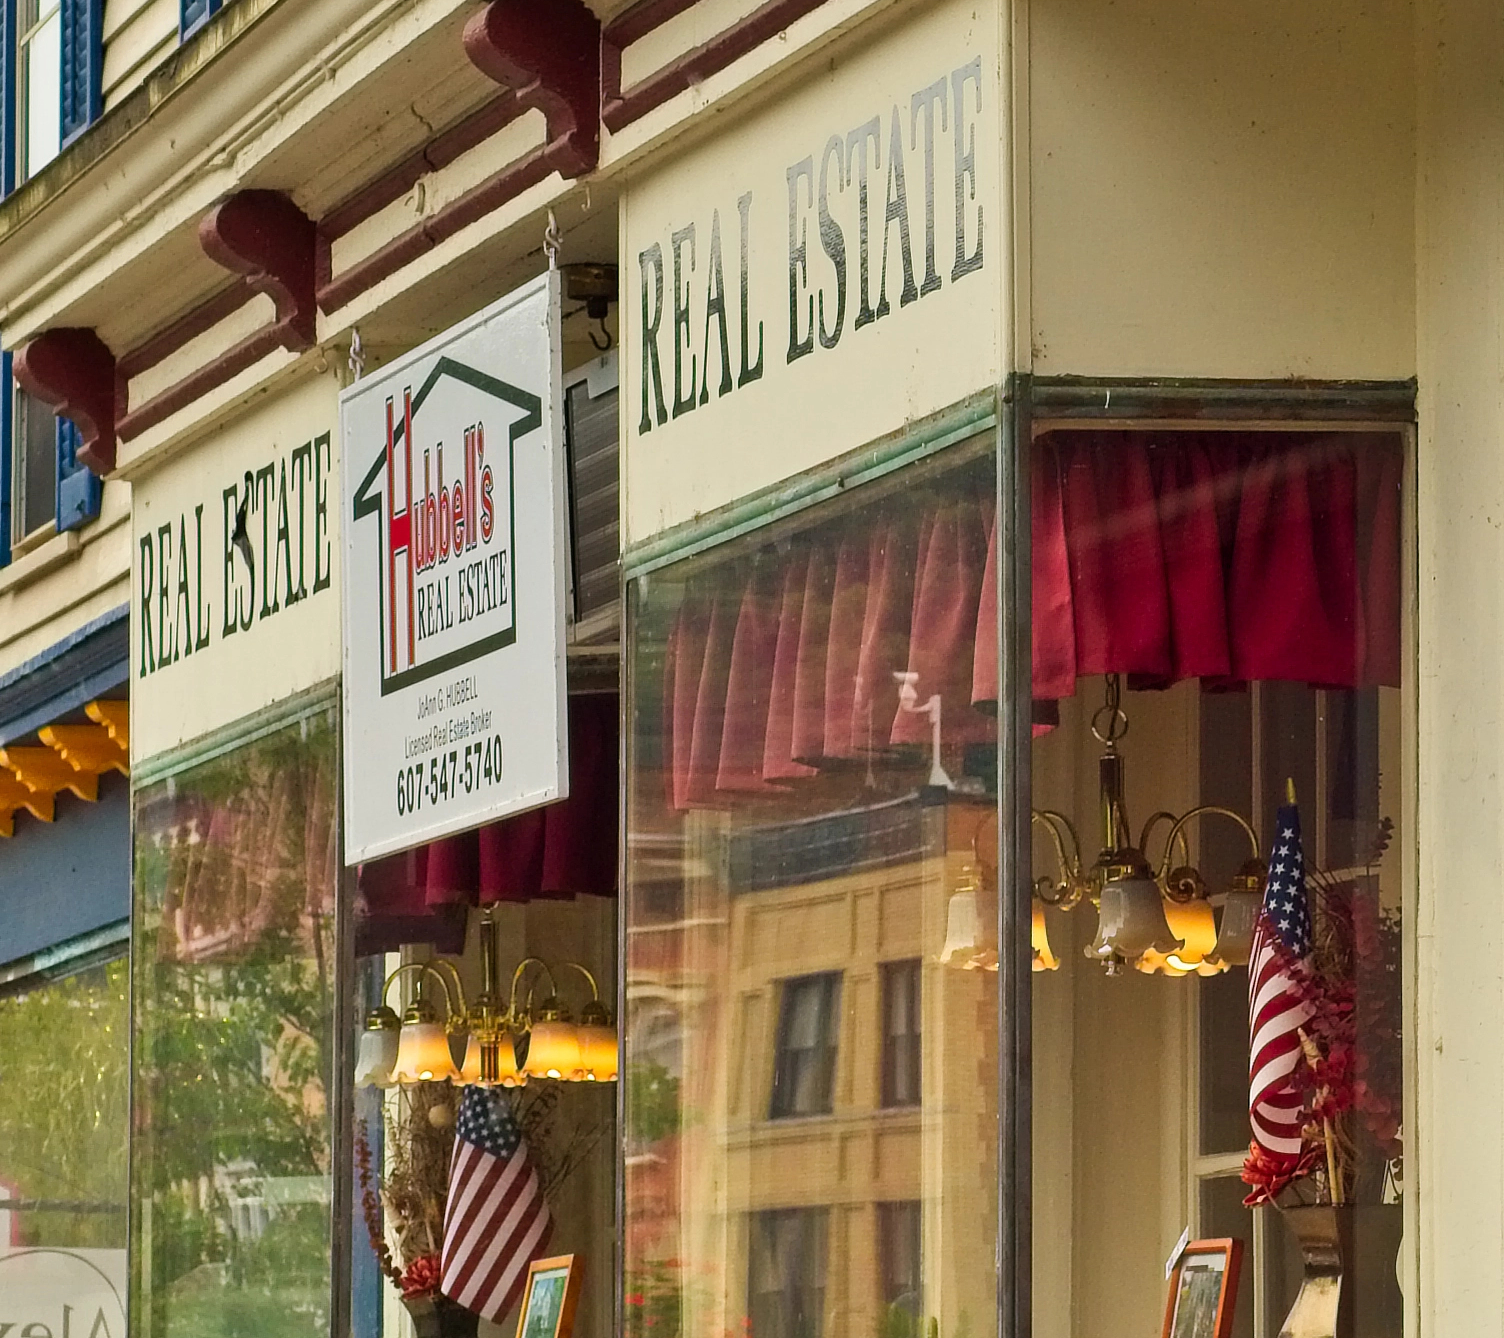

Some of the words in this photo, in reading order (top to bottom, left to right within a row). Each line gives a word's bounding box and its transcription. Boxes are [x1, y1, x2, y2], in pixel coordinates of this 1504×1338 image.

[637, 189, 765, 437] REAL
[785, 54, 985, 366] ESTATE
[138, 503, 212, 679] REAL
[221, 430, 332, 640] ESTATE
[385, 385, 494, 677] Hubbell's
[417, 576, 454, 642] REAL
[458, 550, 508, 625] ESTATE
[404, 727, 433, 760] Licensed
[433, 721, 448, 748] Real
[449, 716, 470, 743] Estate
[470, 709, 493, 737] Broker
[446, 675, 479, 708] HUBBELL
[397, 734, 503, 817] 607-547-5740
